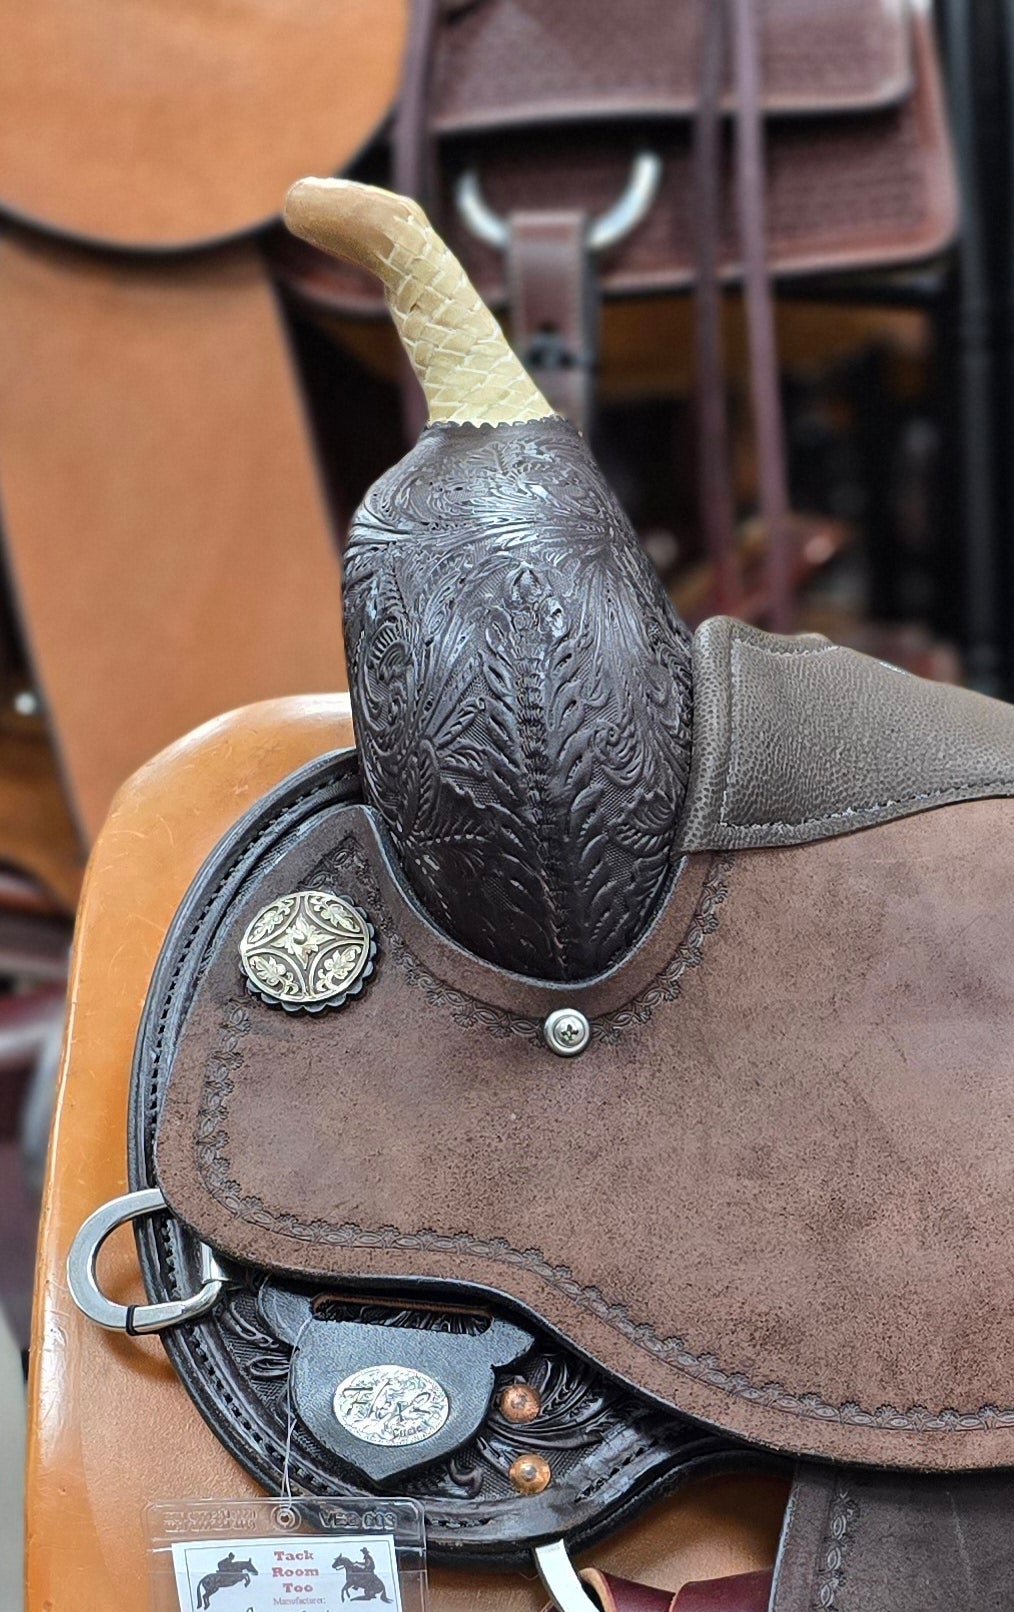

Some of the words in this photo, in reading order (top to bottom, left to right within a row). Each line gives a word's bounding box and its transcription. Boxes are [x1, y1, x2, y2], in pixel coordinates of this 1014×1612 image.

[274, 1550, 314, 1561] Tack
[272, 1566, 320, 1578] Room
[282, 1582, 314, 1593] Too
